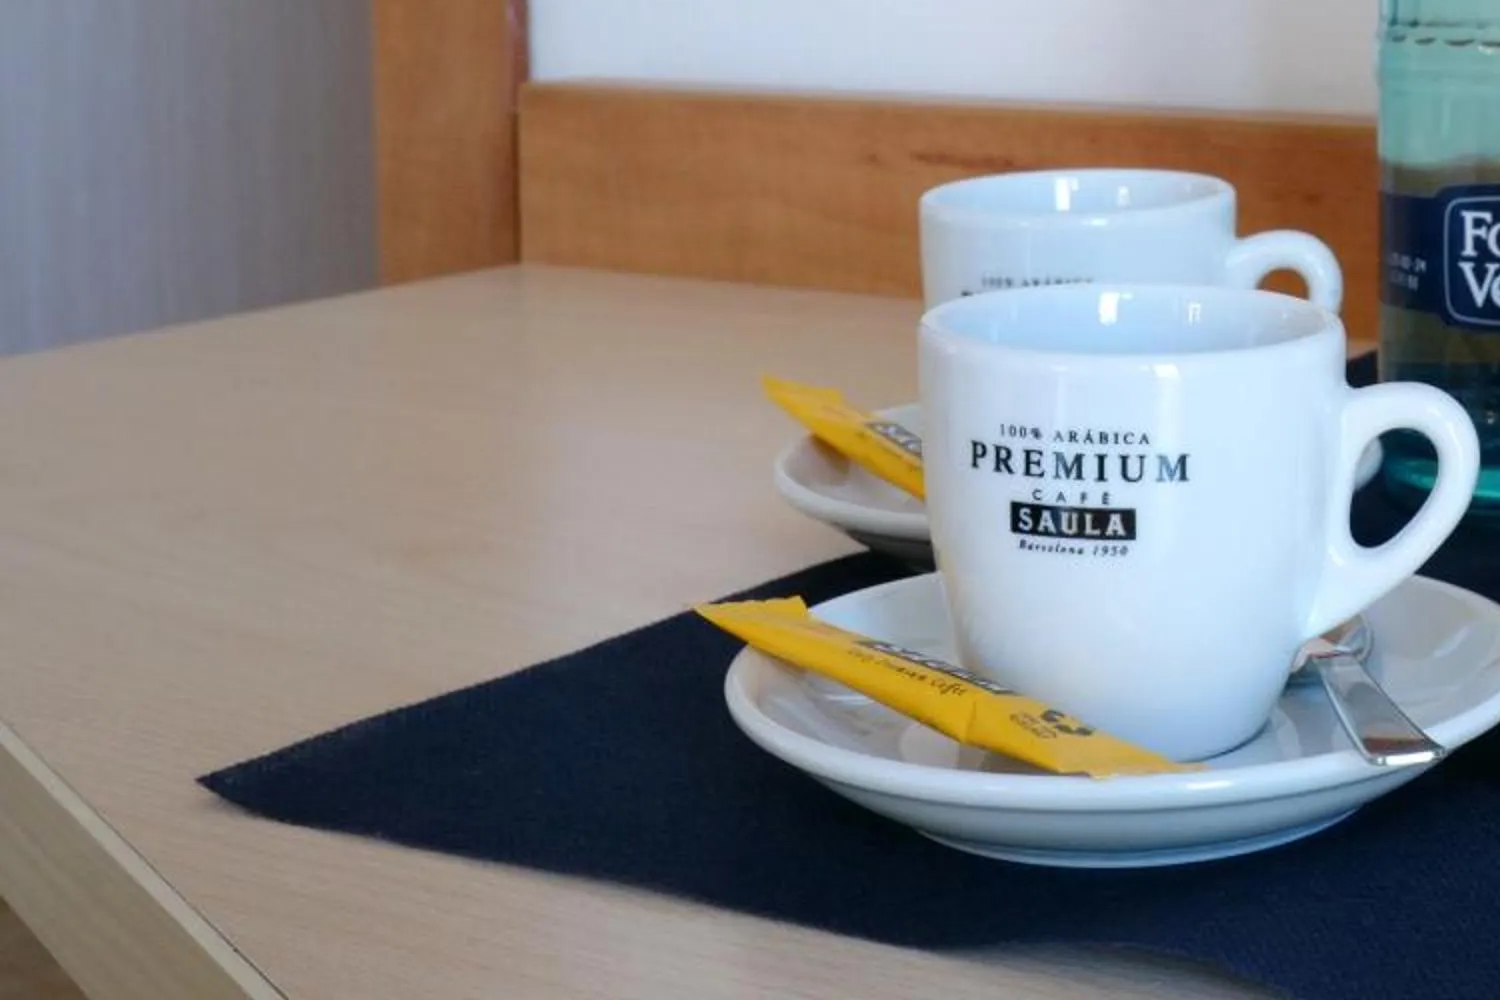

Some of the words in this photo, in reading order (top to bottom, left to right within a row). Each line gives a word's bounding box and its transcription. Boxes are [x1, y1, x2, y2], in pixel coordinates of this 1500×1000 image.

[999, 423, 1043, 440] 100%
[1053, 427, 1151, 446] ARÁBICA
[970, 441, 1190, 482] PREMIUM
[1017, 506, 1127, 537] SAULA
[1018, 539, 1085, 556] Barcelona
